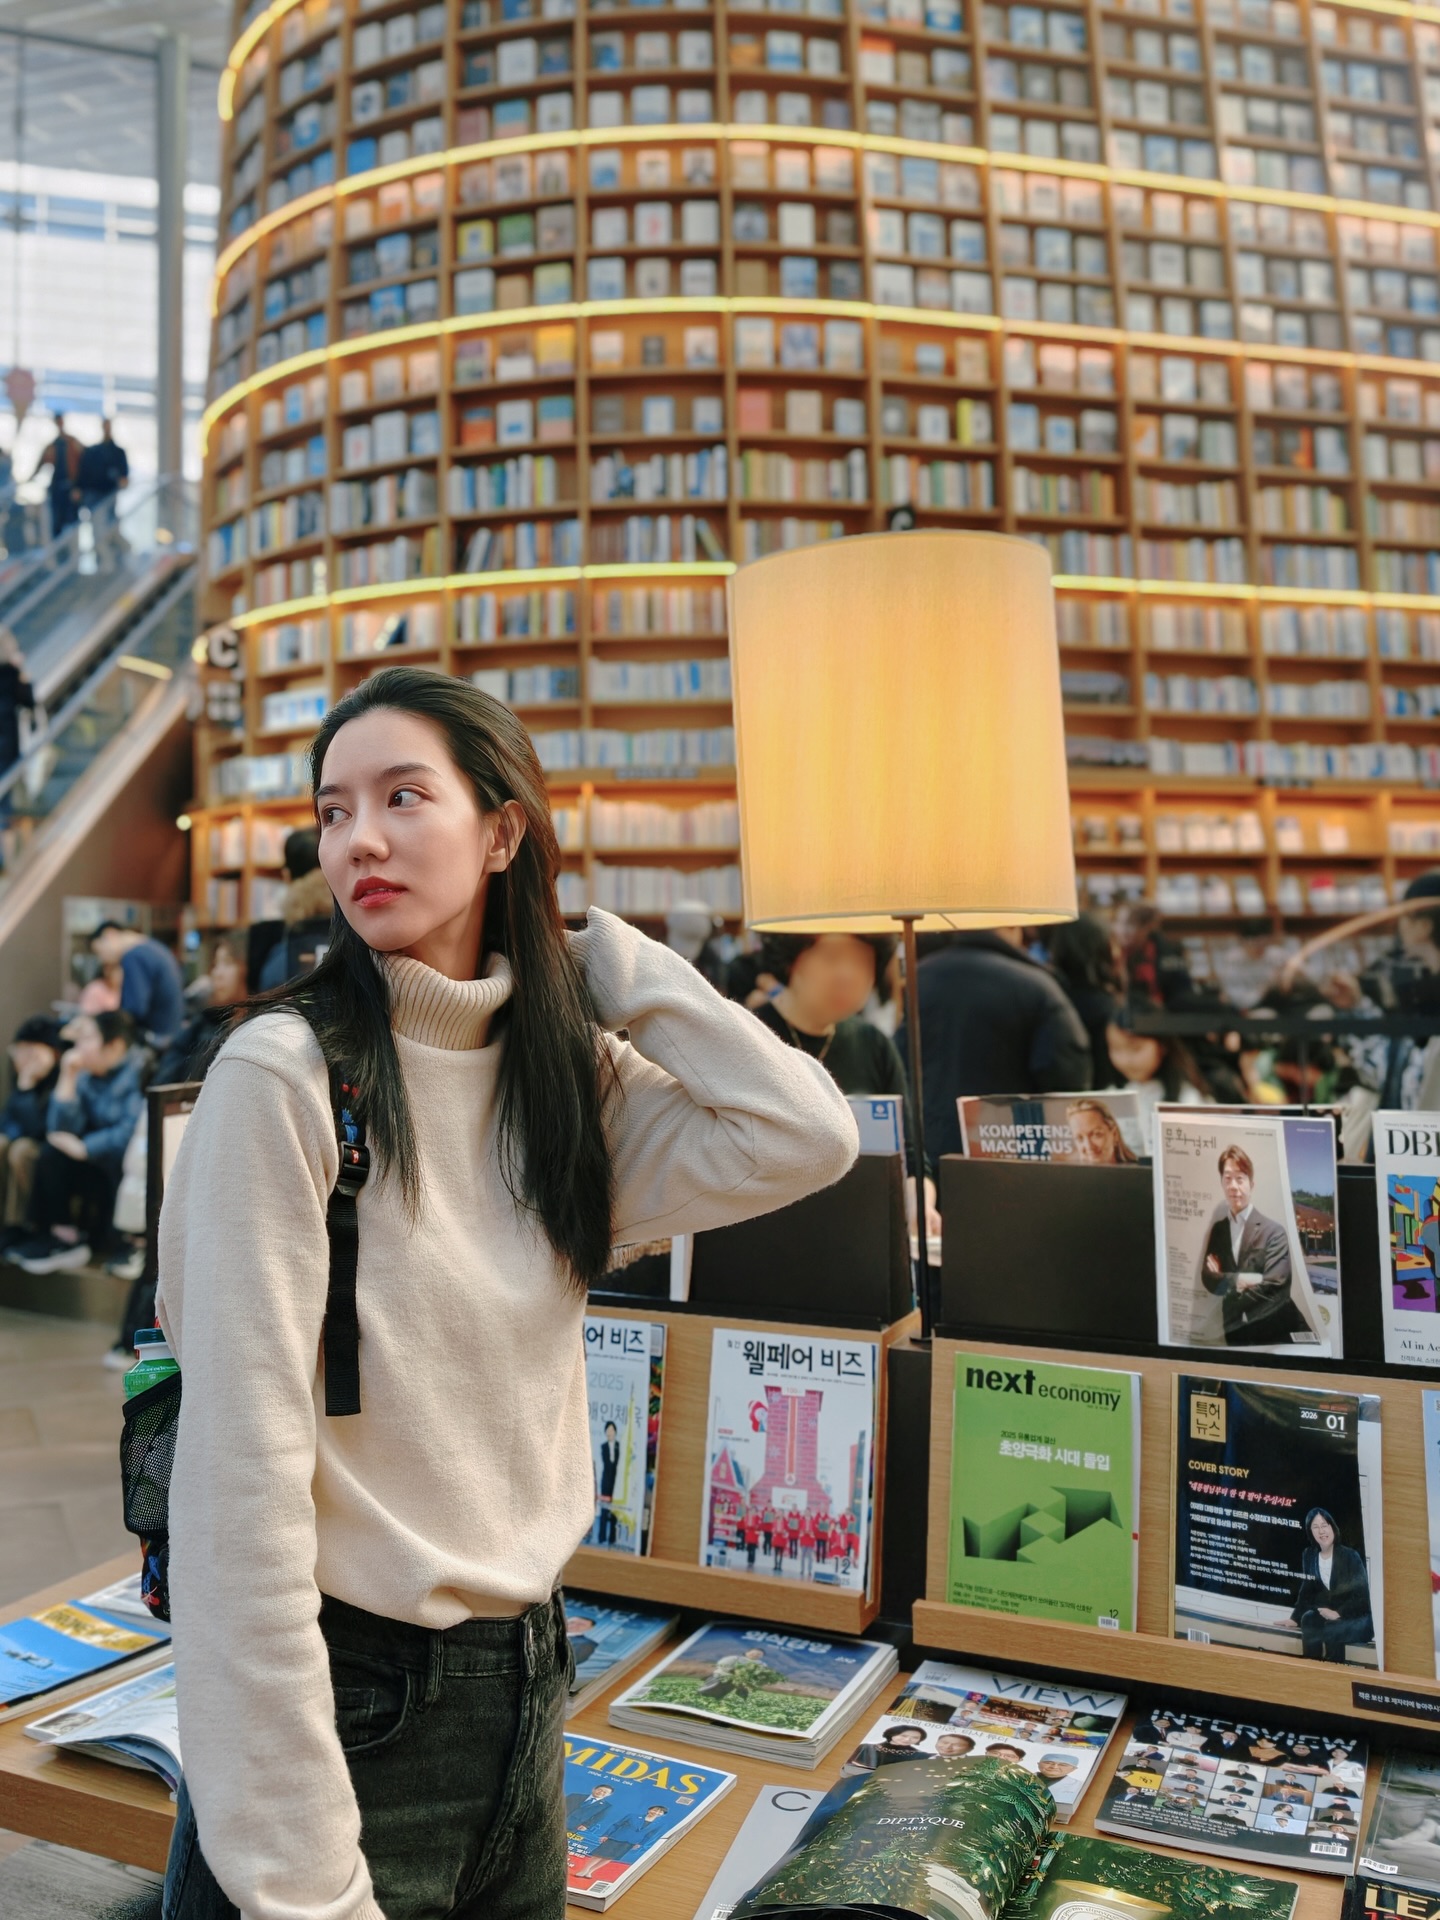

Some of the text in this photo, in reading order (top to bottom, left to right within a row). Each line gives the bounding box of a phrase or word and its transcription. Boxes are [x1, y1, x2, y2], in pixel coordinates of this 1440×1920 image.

[979, 1124, 1073, 1138] KOMPETENZ
[980, 1139, 1073, 1154] MACHT AUS
[610, 1327, 645, 1354] 비즈
[1415, 1342, 1424, 1350] in
[743, 1340, 813, 1376] 웰페어
[821, 1348, 866, 1377] 비즈
[589, 1372, 624, 1391] 2025
[966, 1367, 1121, 1412] next economy
[1196, 1401, 1221, 1420] 특허
[1300, 1410, 1345, 1431] 2026 01
[1196, 1418, 1221, 1438] 뉴스
[999, 1440, 1110, 1471] 초양극화 시대 돌입
[1188, 1459, 1250, 1479] COVER STORY
[833, 1556, 852, 1575] 12
[1109, 1608, 1119, 1619] 12
[992, 1674, 1117, 1711] VIEW
[1151, 1708, 1358, 1753] INTERVIEW
[563, 1741, 706, 1795] MIDAS
[771, 1790, 812, 1812] C
[876, 1816, 966, 1830] DIPTYQUE
